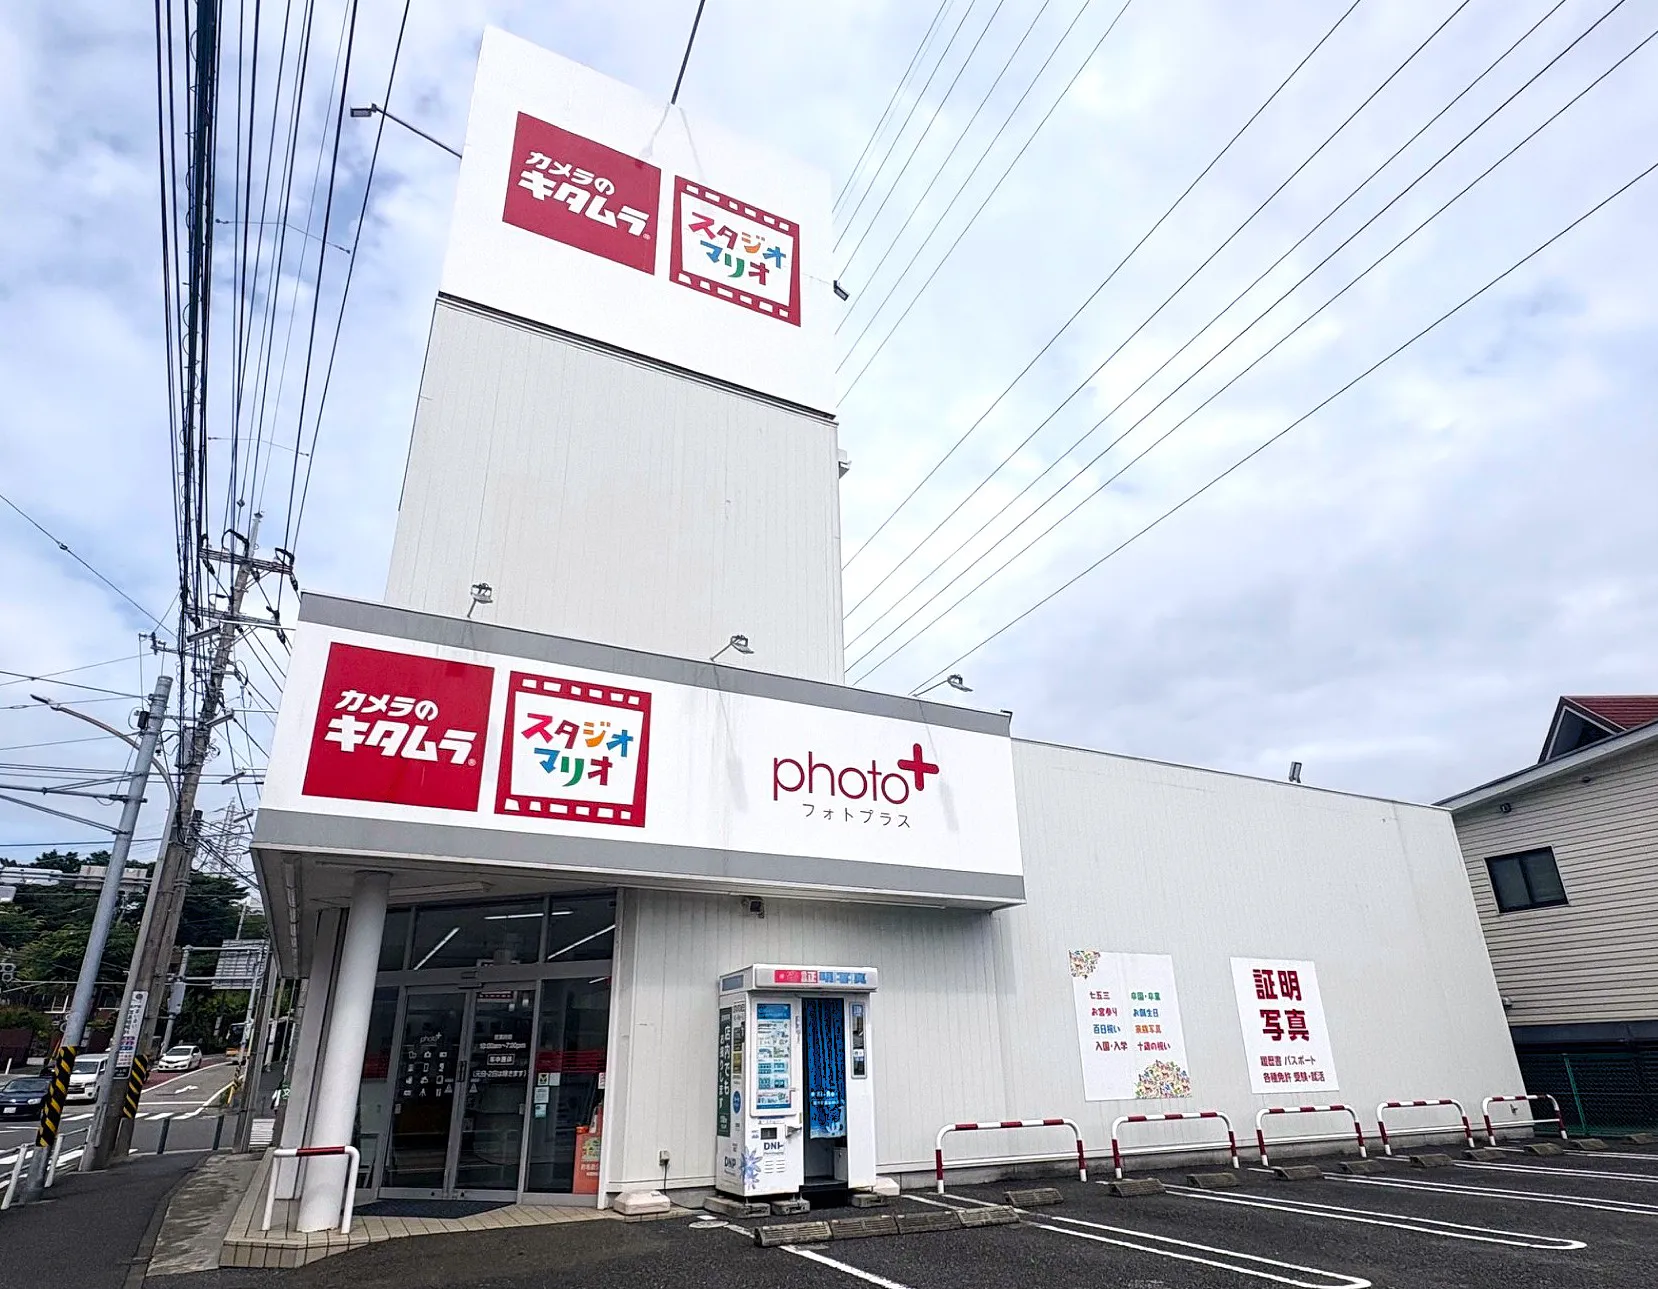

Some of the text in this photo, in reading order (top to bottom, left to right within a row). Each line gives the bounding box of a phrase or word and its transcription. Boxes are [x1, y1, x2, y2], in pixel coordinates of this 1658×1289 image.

[525, 151, 616, 195] カメラの
[518, 170, 650, 240] キタムラ
[688, 212, 786, 269] スタジオ
[700, 240, 770, 286] マリオ
[334, 689, 439, 721] カメラの
[324, 715, 477, 766] キタムラ
[521, 713, 634, 757] スタジオ
[534, 748, 613, 787] マリオ
[802, 803, 910, 828] フォトプラス
[1090, 991, 1110, 1000] 七五三
[1253, 969, 1302, 1001] 証明
[1091, 1007, 1118, 1017] お宮参り
[1133, 1008, 1159, 1017] お誕生日
[1259, 1009, 1310, 1041] 写真
[1093, 1024, 1121, 1034] 百日祝い
[1284, 1055, 1316, 1066] パスポート
